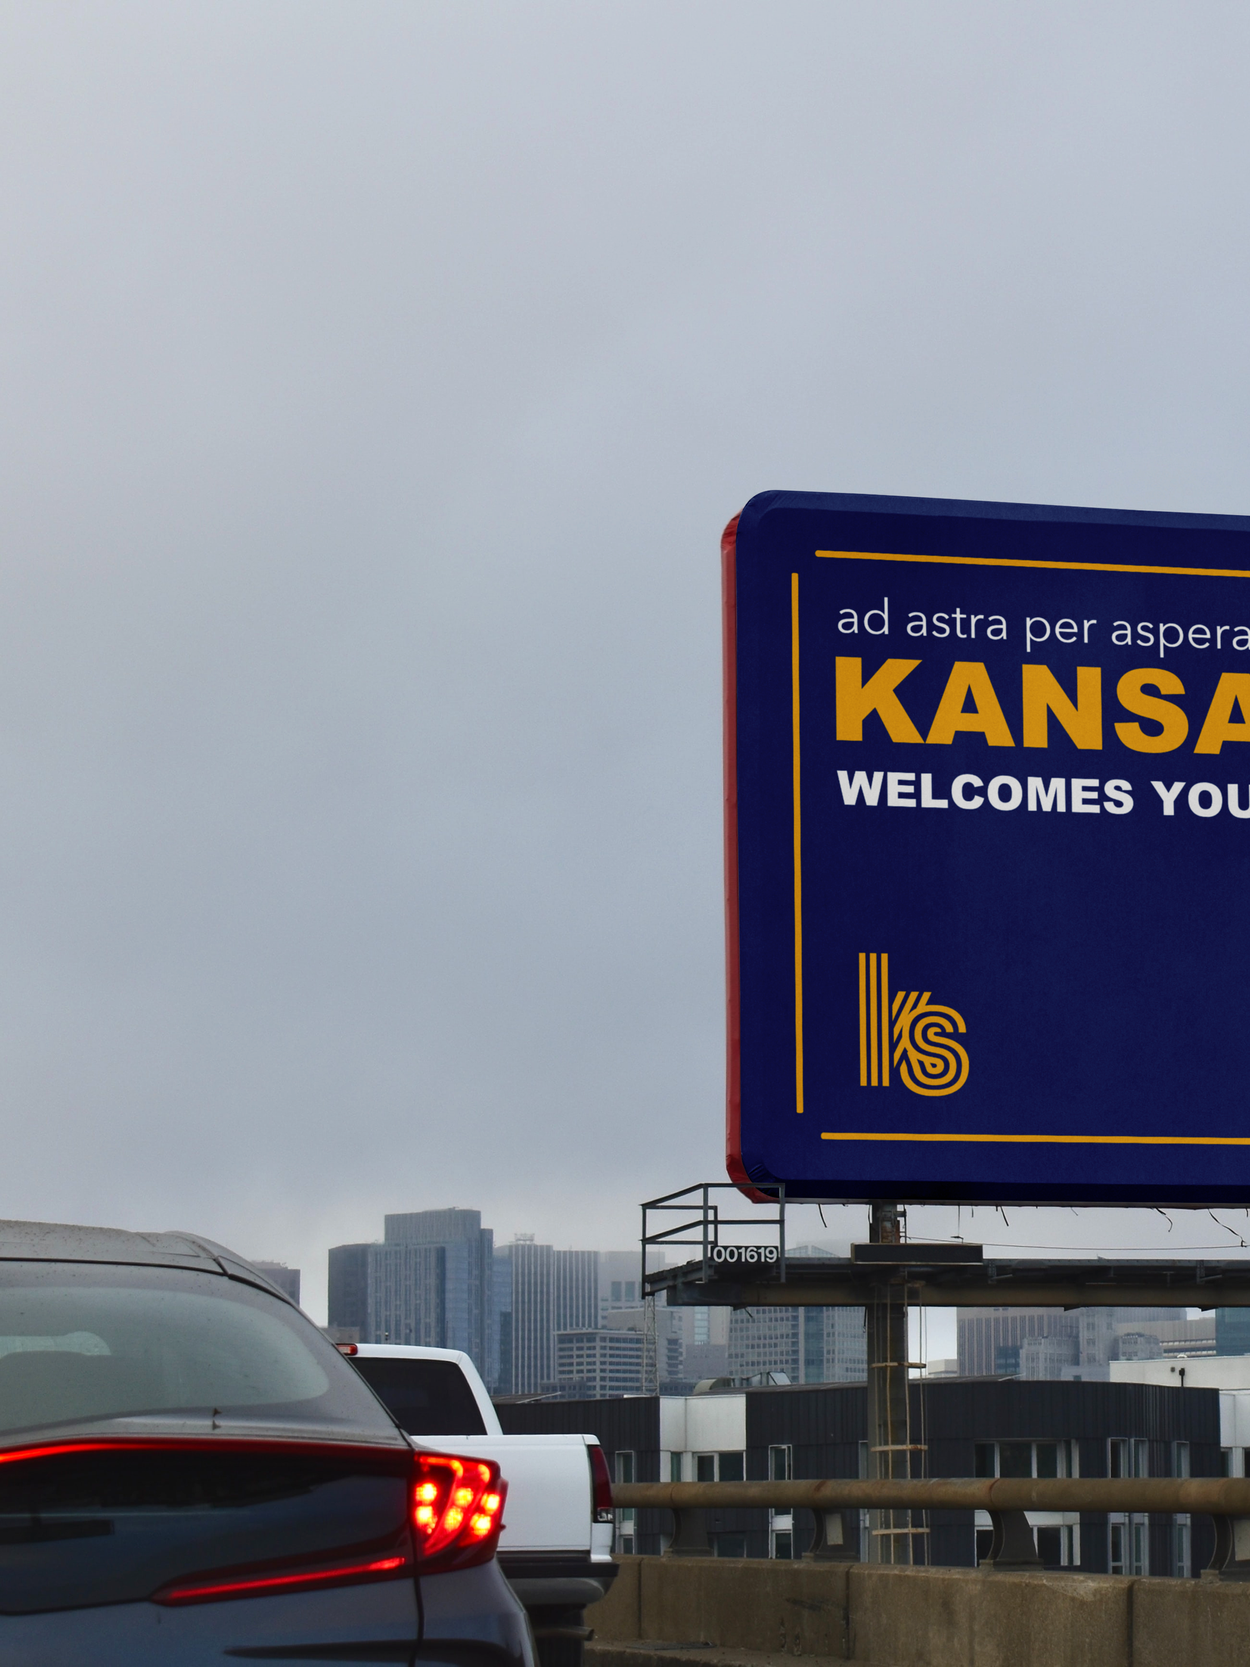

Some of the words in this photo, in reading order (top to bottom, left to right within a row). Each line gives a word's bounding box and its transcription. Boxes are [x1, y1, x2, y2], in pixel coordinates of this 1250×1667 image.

[836, 597, 889, 636] ad
[906, 607, 1008, 641] astra
[1025, 616, 1097, 652] per
[837, 770, 1134, 815] WELCOMES
[712, 1246, 778, 1263] 001619
